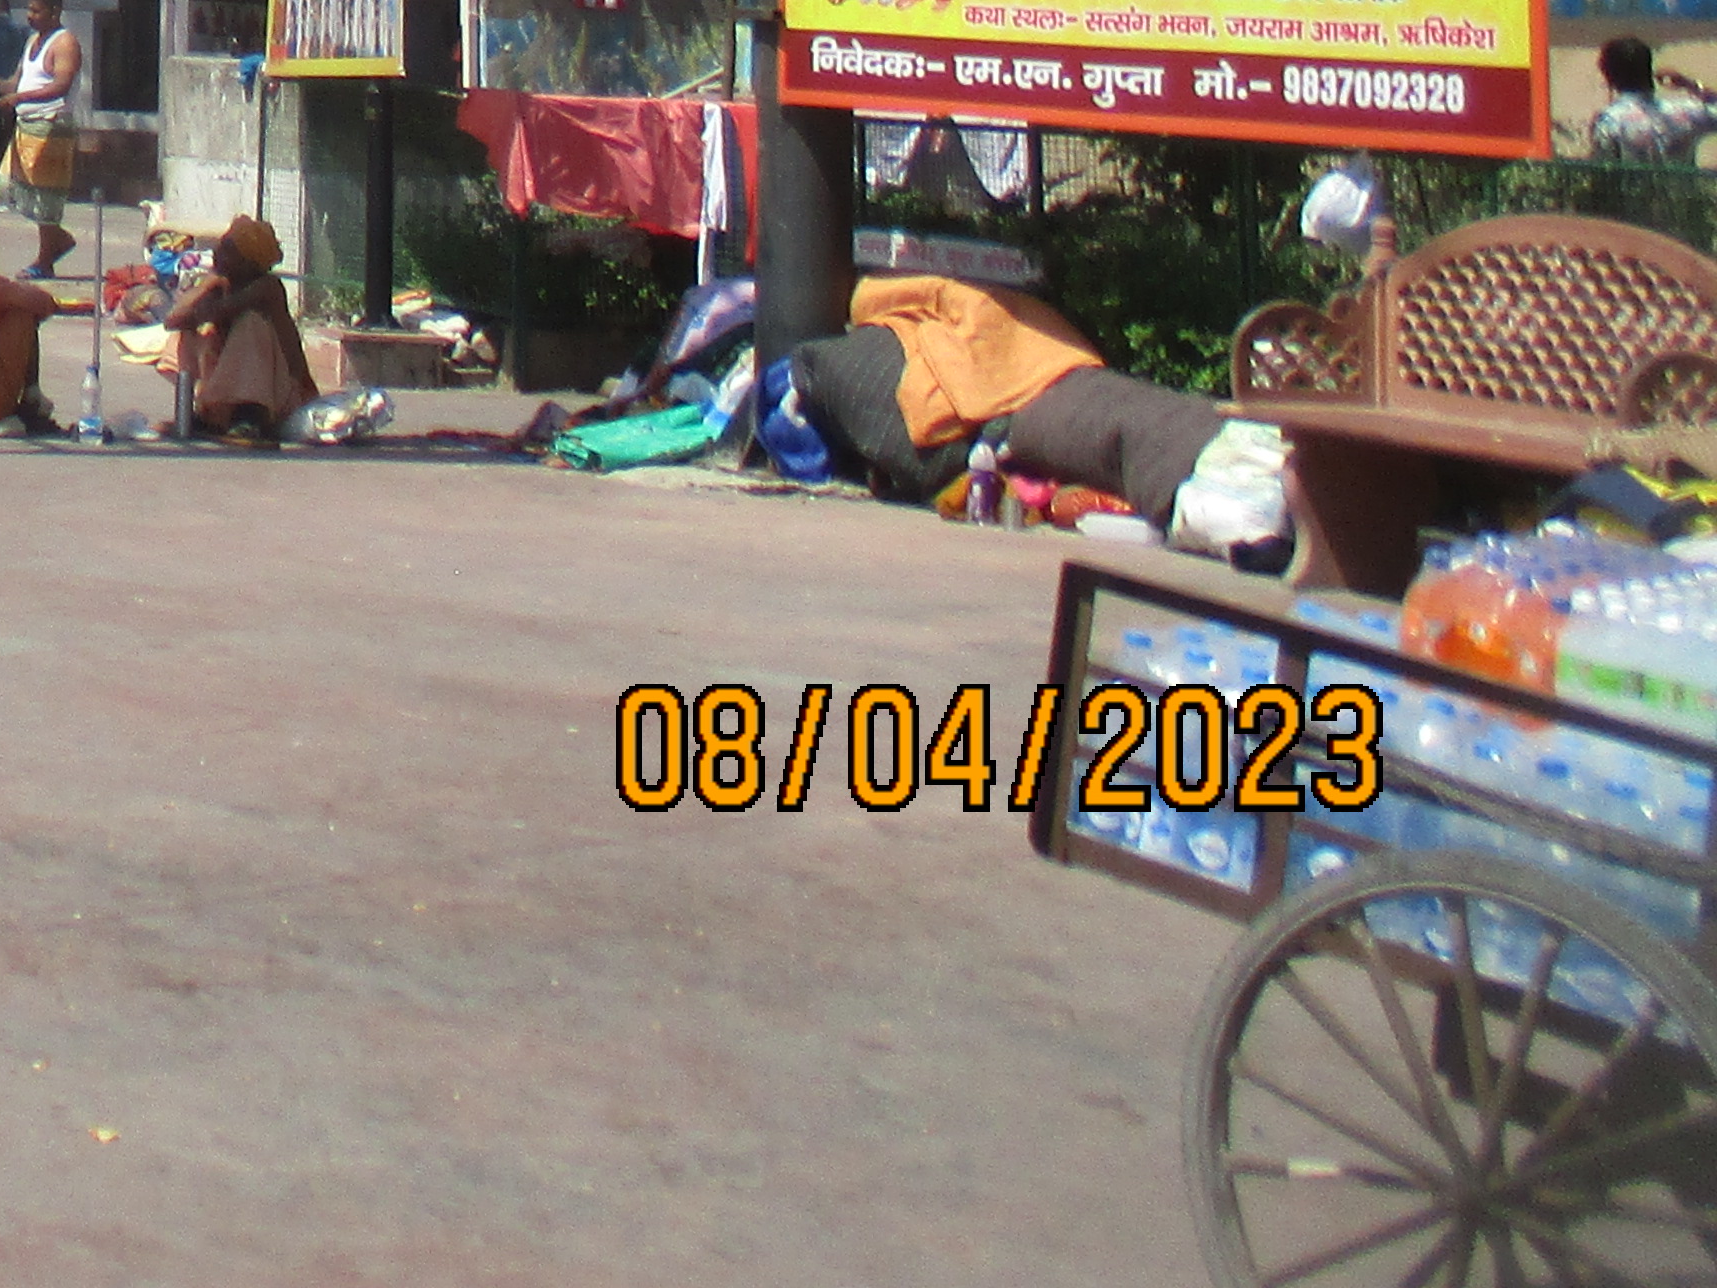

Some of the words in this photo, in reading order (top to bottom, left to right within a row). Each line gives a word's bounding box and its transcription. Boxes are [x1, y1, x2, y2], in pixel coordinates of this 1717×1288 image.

[965, 6, 1004, 28] कथा
[1086, 6, 1151, 34] सत्संग
[1226, 16, 1304, 42] जयराम
[1399, 14, 1495, 50] ऋषिकेश
[954, 54, 1073, 91] एम.एन.
[1081, 62, 1166, 109] गुप्ता
[1283, 64, 1465, 114] 9837092328
